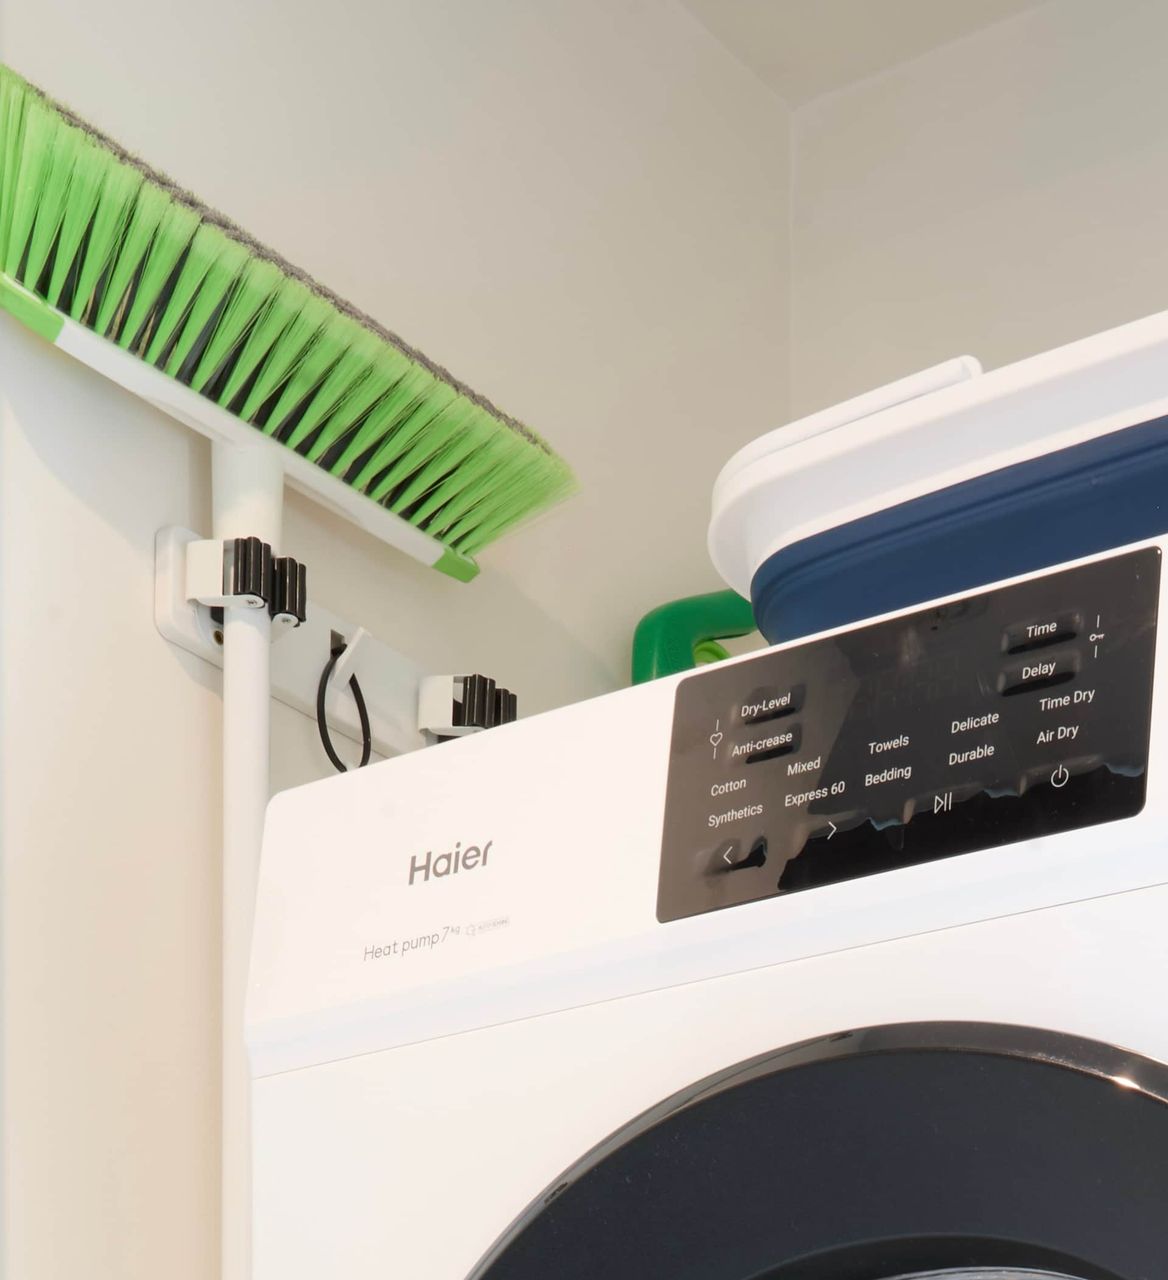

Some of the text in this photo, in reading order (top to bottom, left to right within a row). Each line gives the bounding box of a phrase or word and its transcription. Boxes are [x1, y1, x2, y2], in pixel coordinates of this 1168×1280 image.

[1026, 622, 1057, 638] Time
[1022, 662, 1056, 679] Delay
[741, 693, 791, 718] Dry-Level
[1039, 689, 1095, 711] Time Dry
[951, 713, 999, 733] Delicate
[732, 732, 793, 757] Anti-crease
[868, 734, 909, 755] Towels
[1036, 725, 1079, 744] Air Dry
[949, 744, 995, 765] Durable
[787, 756, 821, 776] Mixed
[865, 766, 912, 787] Bedding
[710, 778, 747, 797] Cotton
[784, 781, 845, 807] Express 60
[708, 803, 763, 828] Synthetics
[408, 840, 493, 886] Haier
[363, 941, 398, 961] Heat
[401, 932, 440, 957] pump
